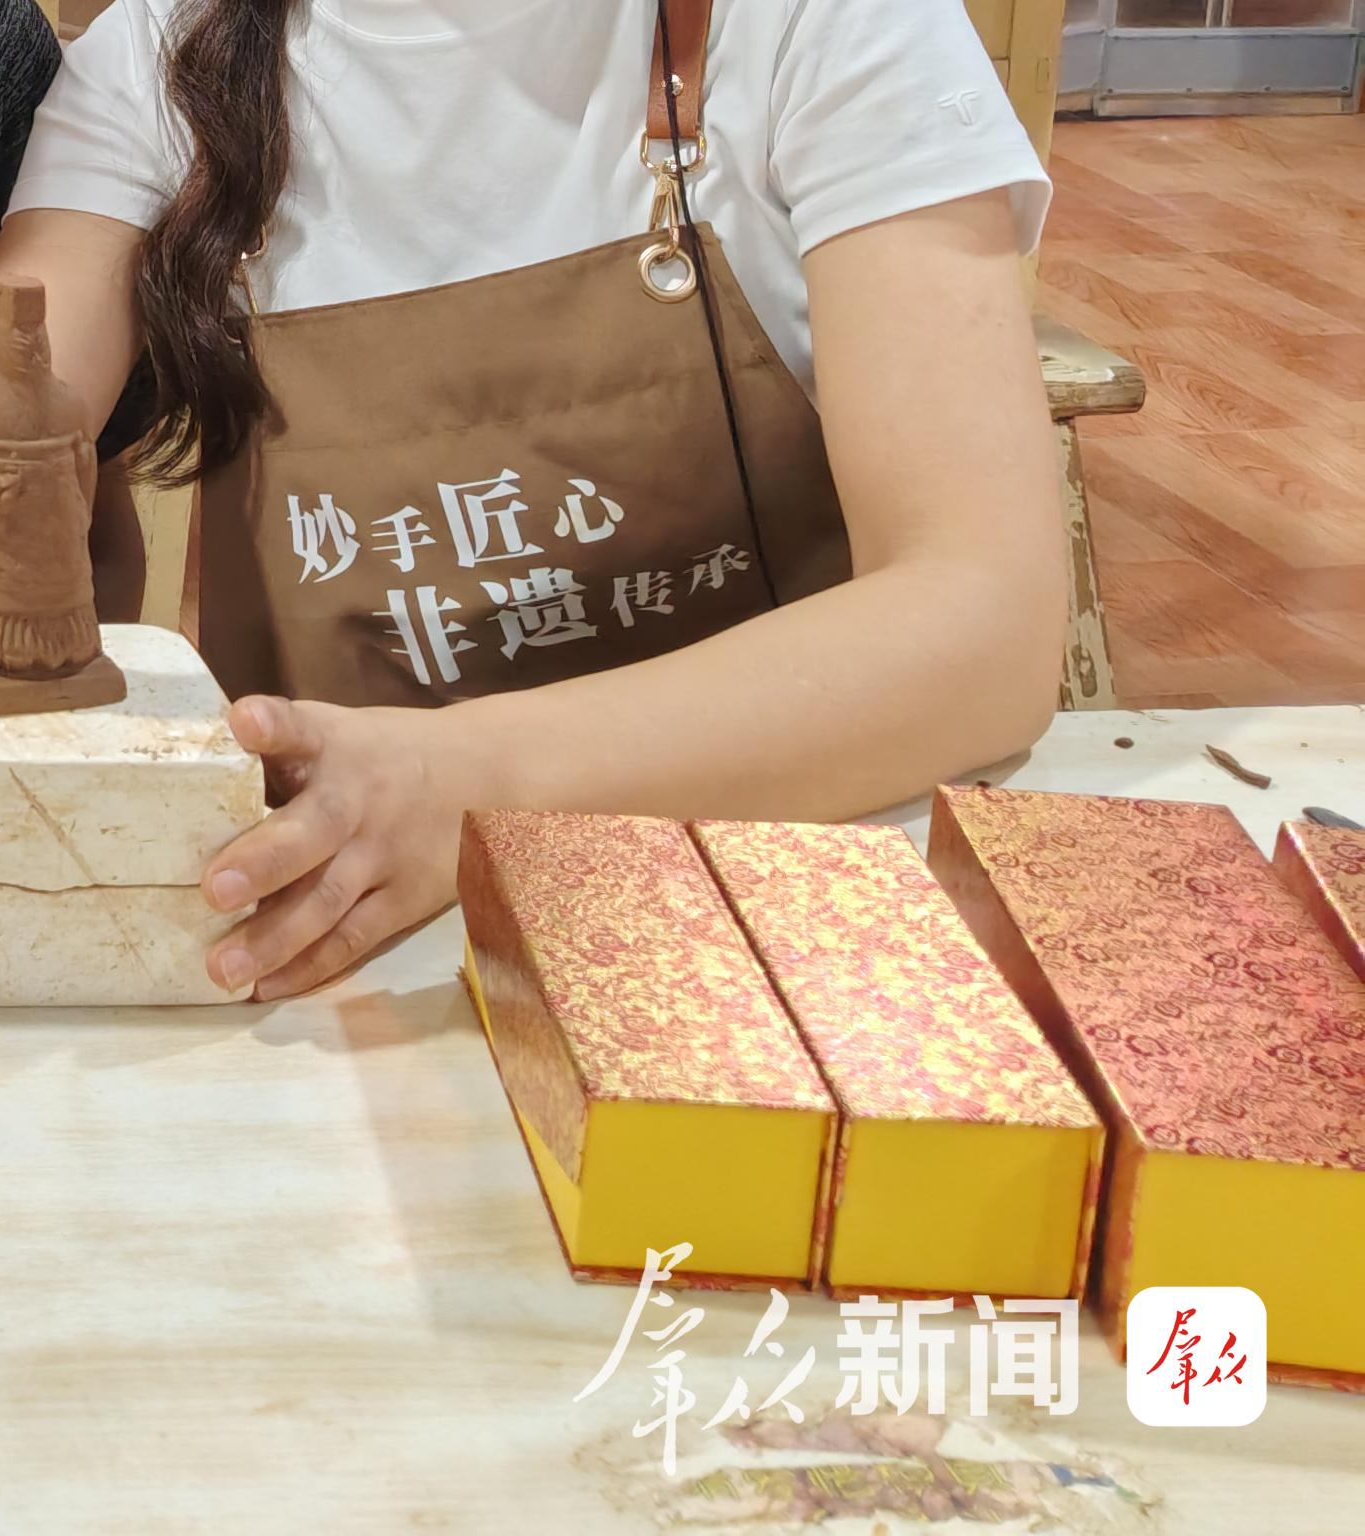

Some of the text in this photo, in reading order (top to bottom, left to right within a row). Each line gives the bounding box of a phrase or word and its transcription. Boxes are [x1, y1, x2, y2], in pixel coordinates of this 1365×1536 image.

[287, 468, 626, 585] 妙手匠心
[369, 543, 754, 686] 非遗传承
